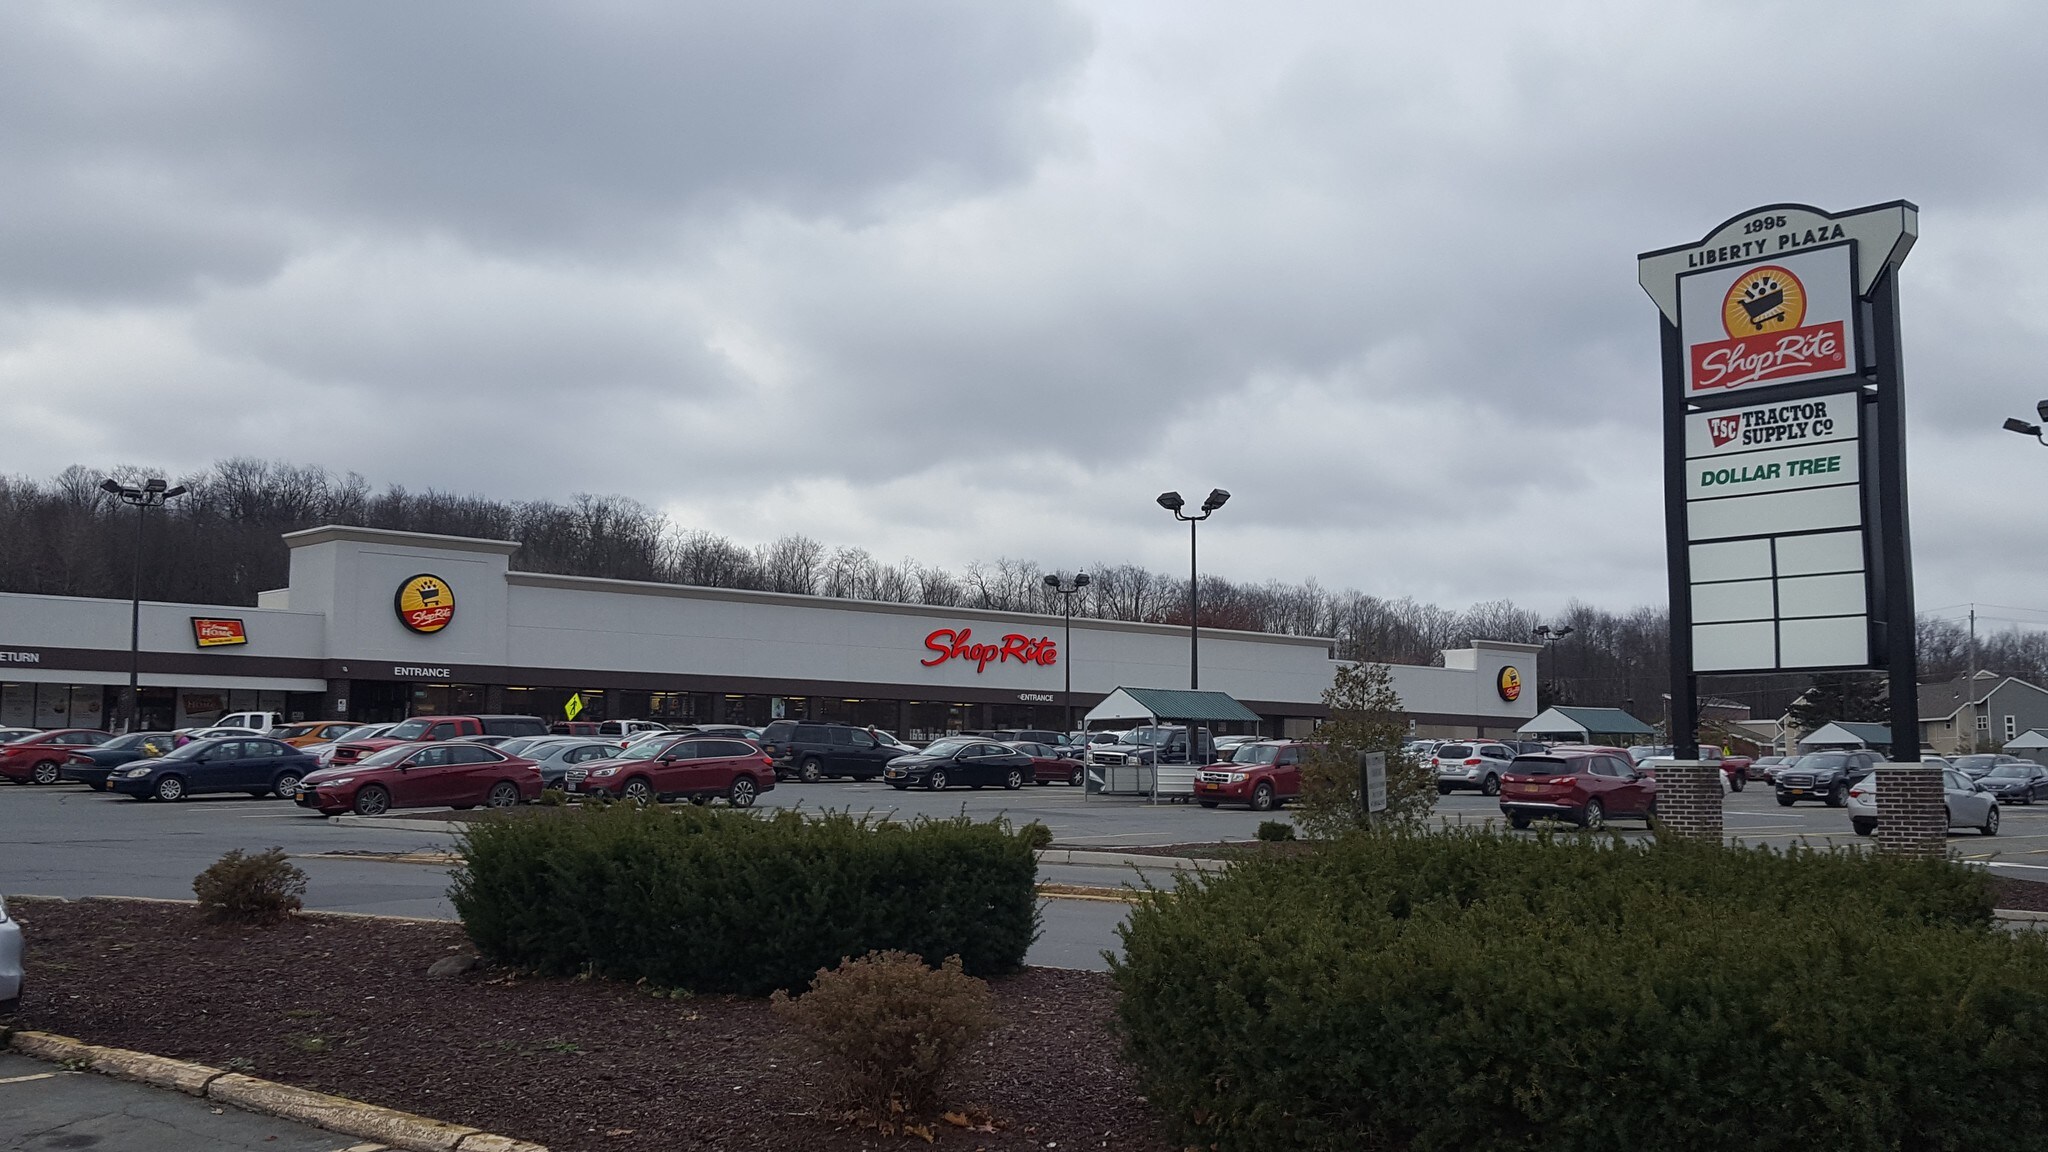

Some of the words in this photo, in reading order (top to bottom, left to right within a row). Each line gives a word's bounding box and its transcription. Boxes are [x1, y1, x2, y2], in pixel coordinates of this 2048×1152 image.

[1743, 215, 1787, 235] 1995
[1688, 238, 1767, 268] LIBERTY
[1778, 223, 1845, 250] PLAZA
[1699, 330, 1836, 382] ShopRite
[1742, 401, 1827, 428] TRACTOR
[1711, 419, 1737, 439] TSC
[1742, 421, 1809, 446] SUPPLY
[1701, 463, 1781, 487] DOLLAR
[1786, 455, 1841, 477] TREE
[412, 607, 451, 626] ShopRite
[0, 651, 40, 663] ETURN
[920, 628, 1057, 674] ShopRite
[394, 666, 450, 678] ENTRANCE
[1020, 693, 1054, 702] ENTRANCE
